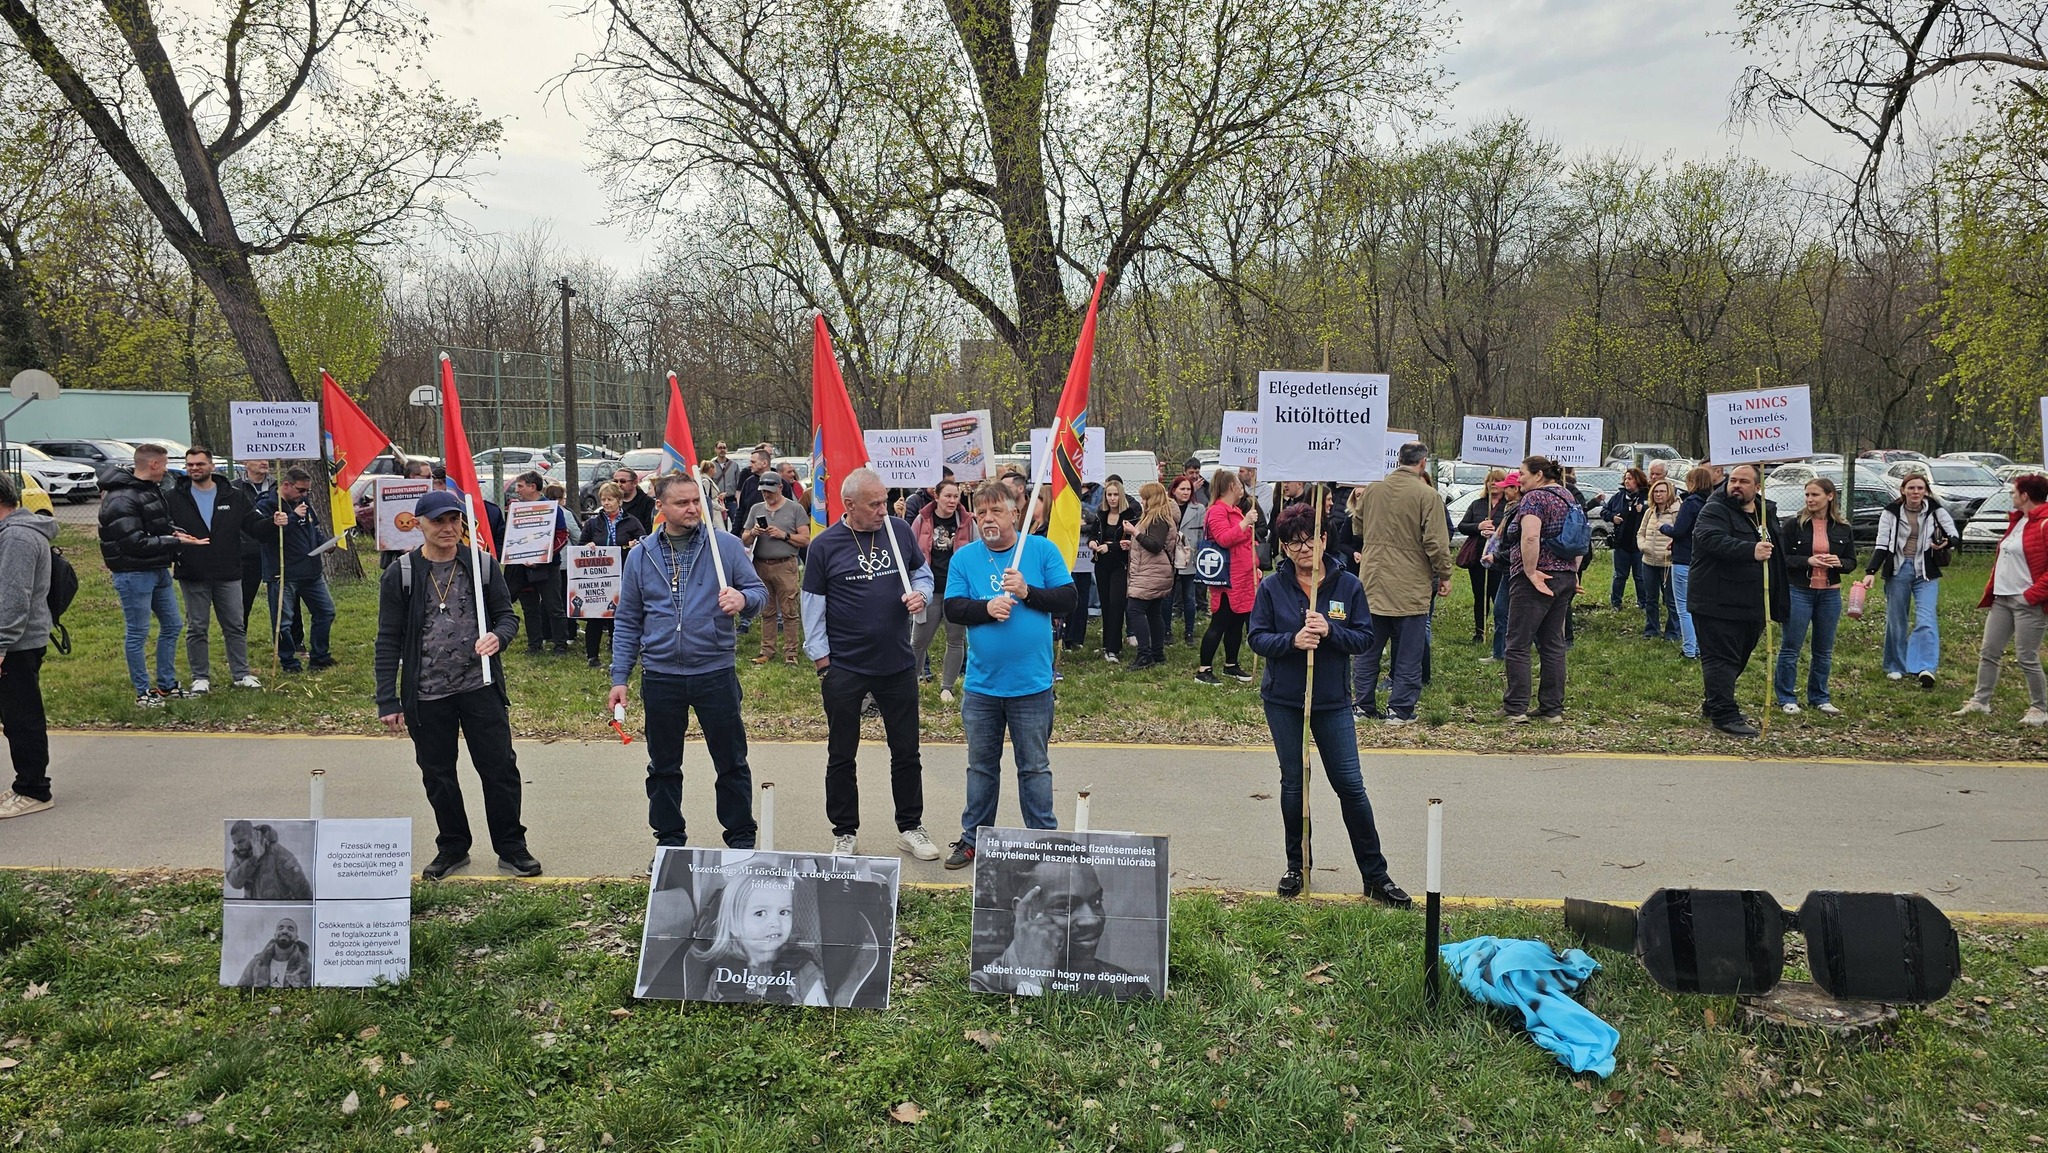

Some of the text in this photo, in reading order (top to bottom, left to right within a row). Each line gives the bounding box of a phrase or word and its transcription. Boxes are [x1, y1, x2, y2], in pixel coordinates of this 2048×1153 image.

[1269, 381, 1378, 399] Elégedetlenségit
[1729, 396, 1787, 412] Ha NINCS
[246, 407, 289, 415] probléma
[1275, 406, 1370, 424] kitöltötted
[261, 419, 297, 427] dolgozó,
[1731, 413, 1788, 425] béremelés,
[1475, 422, 1512, 431] CSALÁD?
[885, 434, 928, 444] LOJALITÁS
[1477, 433, 1509, 444] BARÁT?
[1545, 433, 1586, 442] akarunk,
[1738, 427, 1781, 441] NINCS
[247, 443, 306, 452] RENDSZER
[1308, 438, 1341, 450] már?
[1731, 443, 1789, 455] lelkesedés!
[892, 447, 914, 456] NEM
[1472, 446, 1512, 455] munkahely?
[877, 458, 929, 468] EGYIRÁNYÚ
[1072, 448, 1083, 469] VD
[581, 550, 595, 558] NEM
[590, 567, 609, 575] GOND.
[341, 842, 372, 850] Fizessük
[987, 838, 1155, 856] Ha nem adunk rendes fizetésemelést
[327, 852, 373, 860] dolgozóinkat
[985, 850, 1156, 868] kénytelenek lesznek bejönni túlórába
[343, 861, 377, 870] becsüljük
[380, 861, 396, 869] meg
[337, 869, 398, 877] szakértelmüket?
[688, 863, 737, 878] Vezetőség:
[739, 865, 752, 875] Mi
[755, 866, 799, 878] törődünk
[809, 869, 861, 882] dolgozóink
[751, 879, 794, 891] jólétével!
[373, 920, 410, 928] létszámot
[342, 931, 391, 939] foglalkozzunk
[329, 939, 400, 949] dolgozók igényeivel
[346, 949, 393, 957] dolgoztassuk
[340, 959, 364, 967] jobban
[366, 958, 382, 966] mint
[385, 956, 406, 965] eddig
[716, 967, 797, 989] Dolgozók
[983, 965, 1150, 984] többet dolgozni hogy ne dögöljenek
[1052, 980, 1079, 992] éhen!
